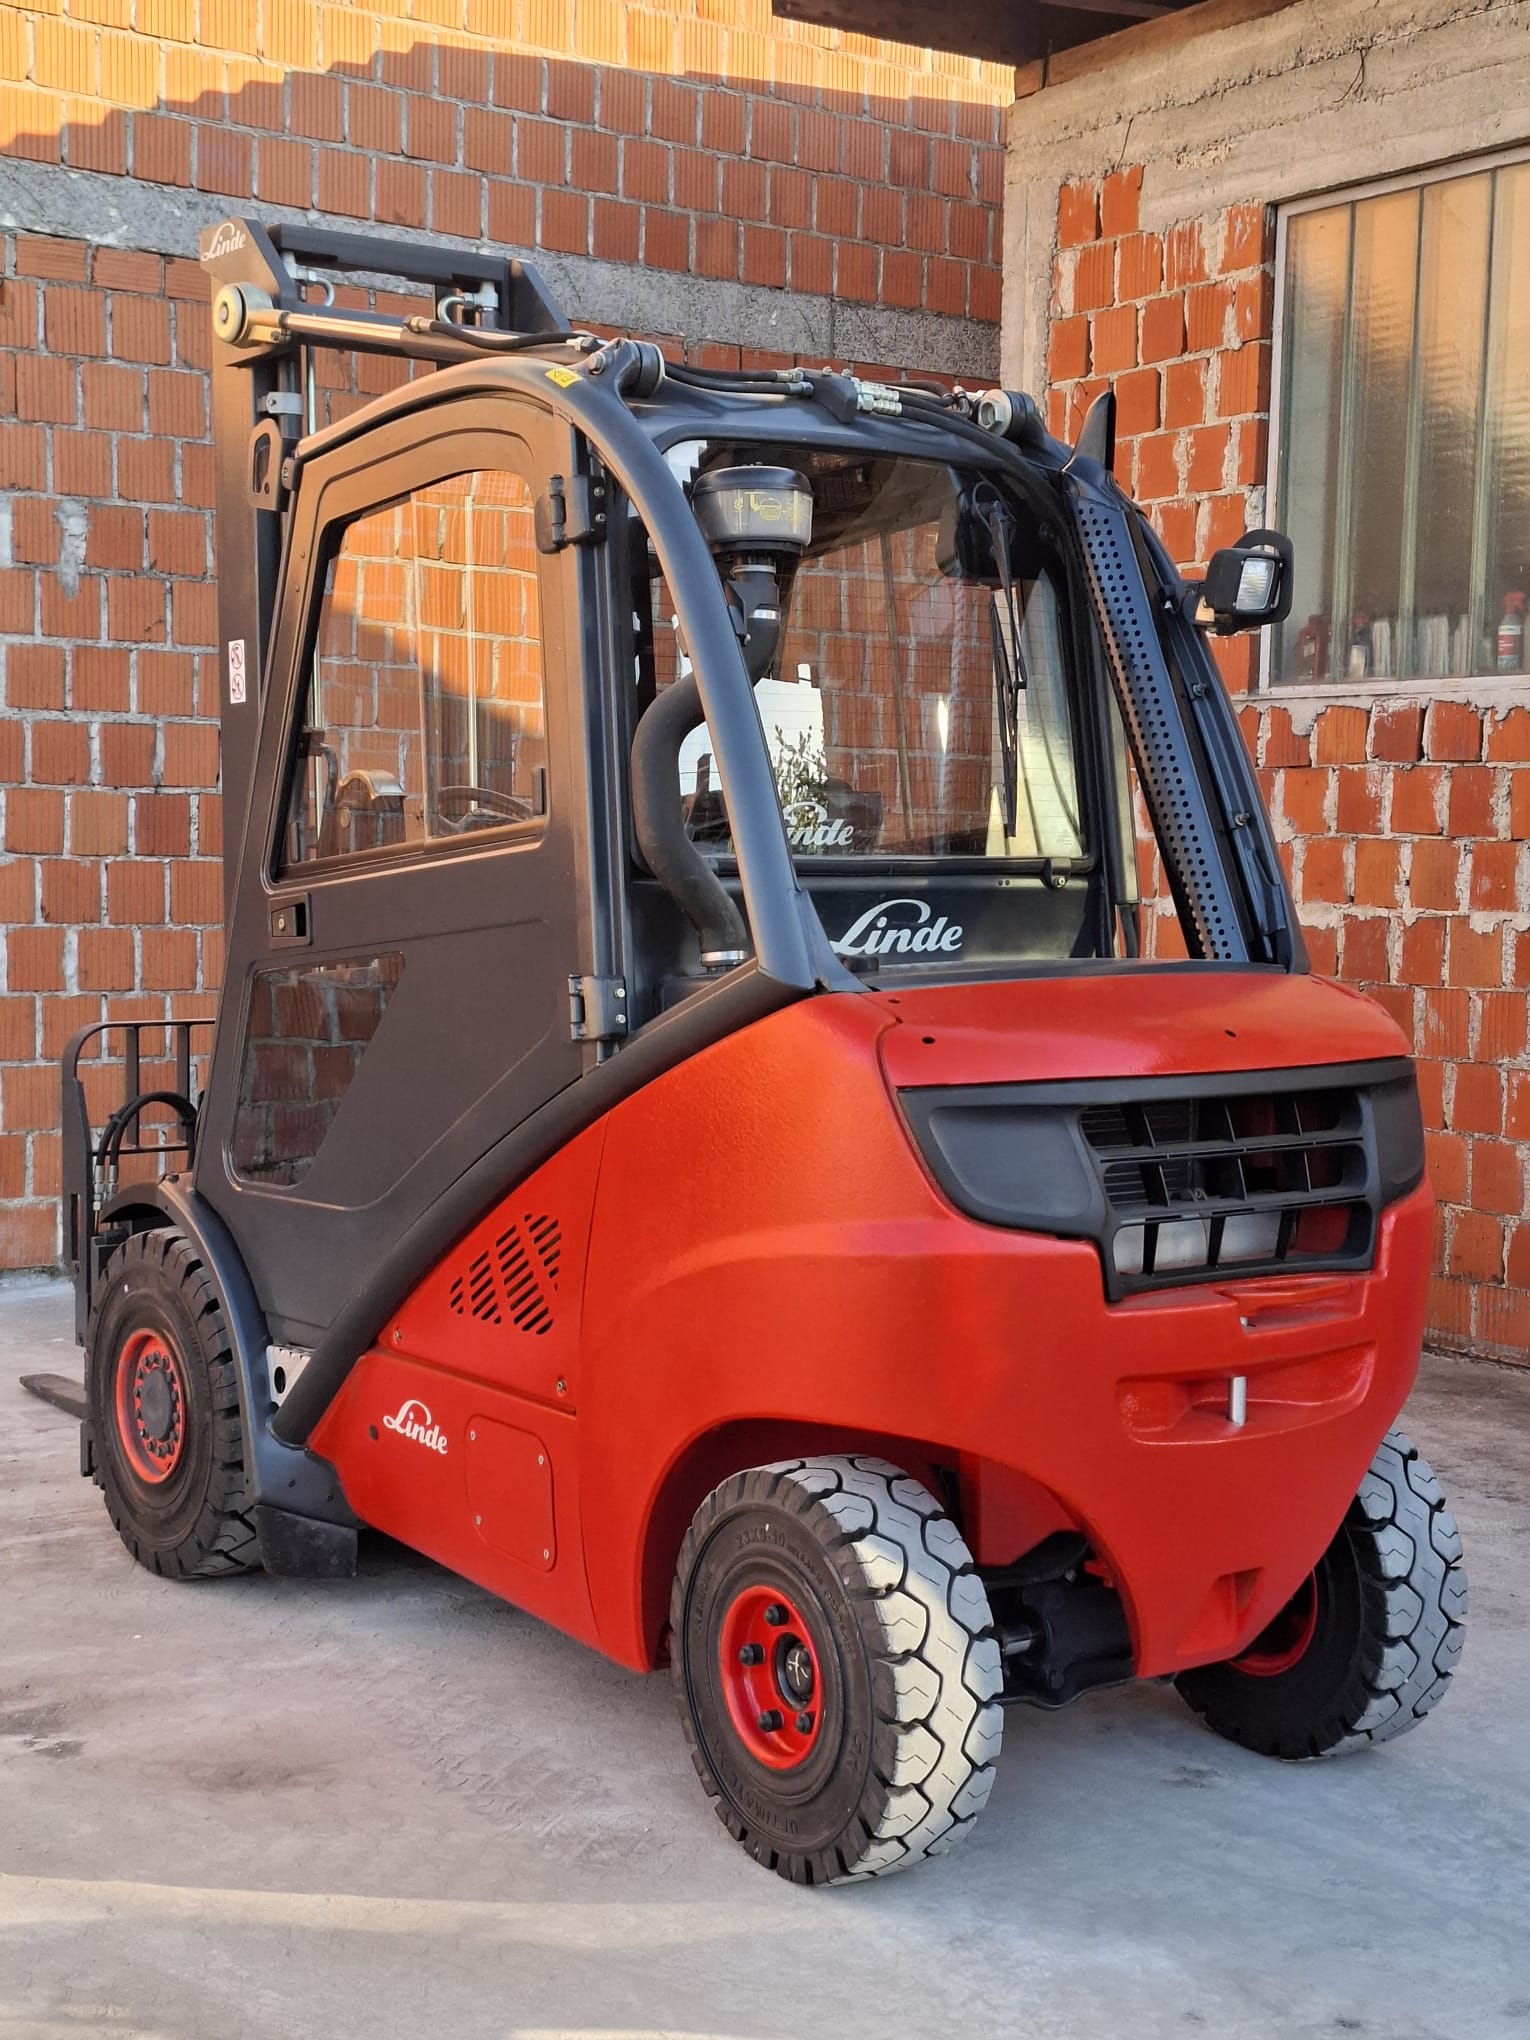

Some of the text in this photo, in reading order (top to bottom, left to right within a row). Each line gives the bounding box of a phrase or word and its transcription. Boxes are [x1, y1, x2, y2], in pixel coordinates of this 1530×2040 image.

[201, 222, 246, 261] Linde
[829, 899, 963, 956] Linde
[383, 1399, 448, 1455] Linde
